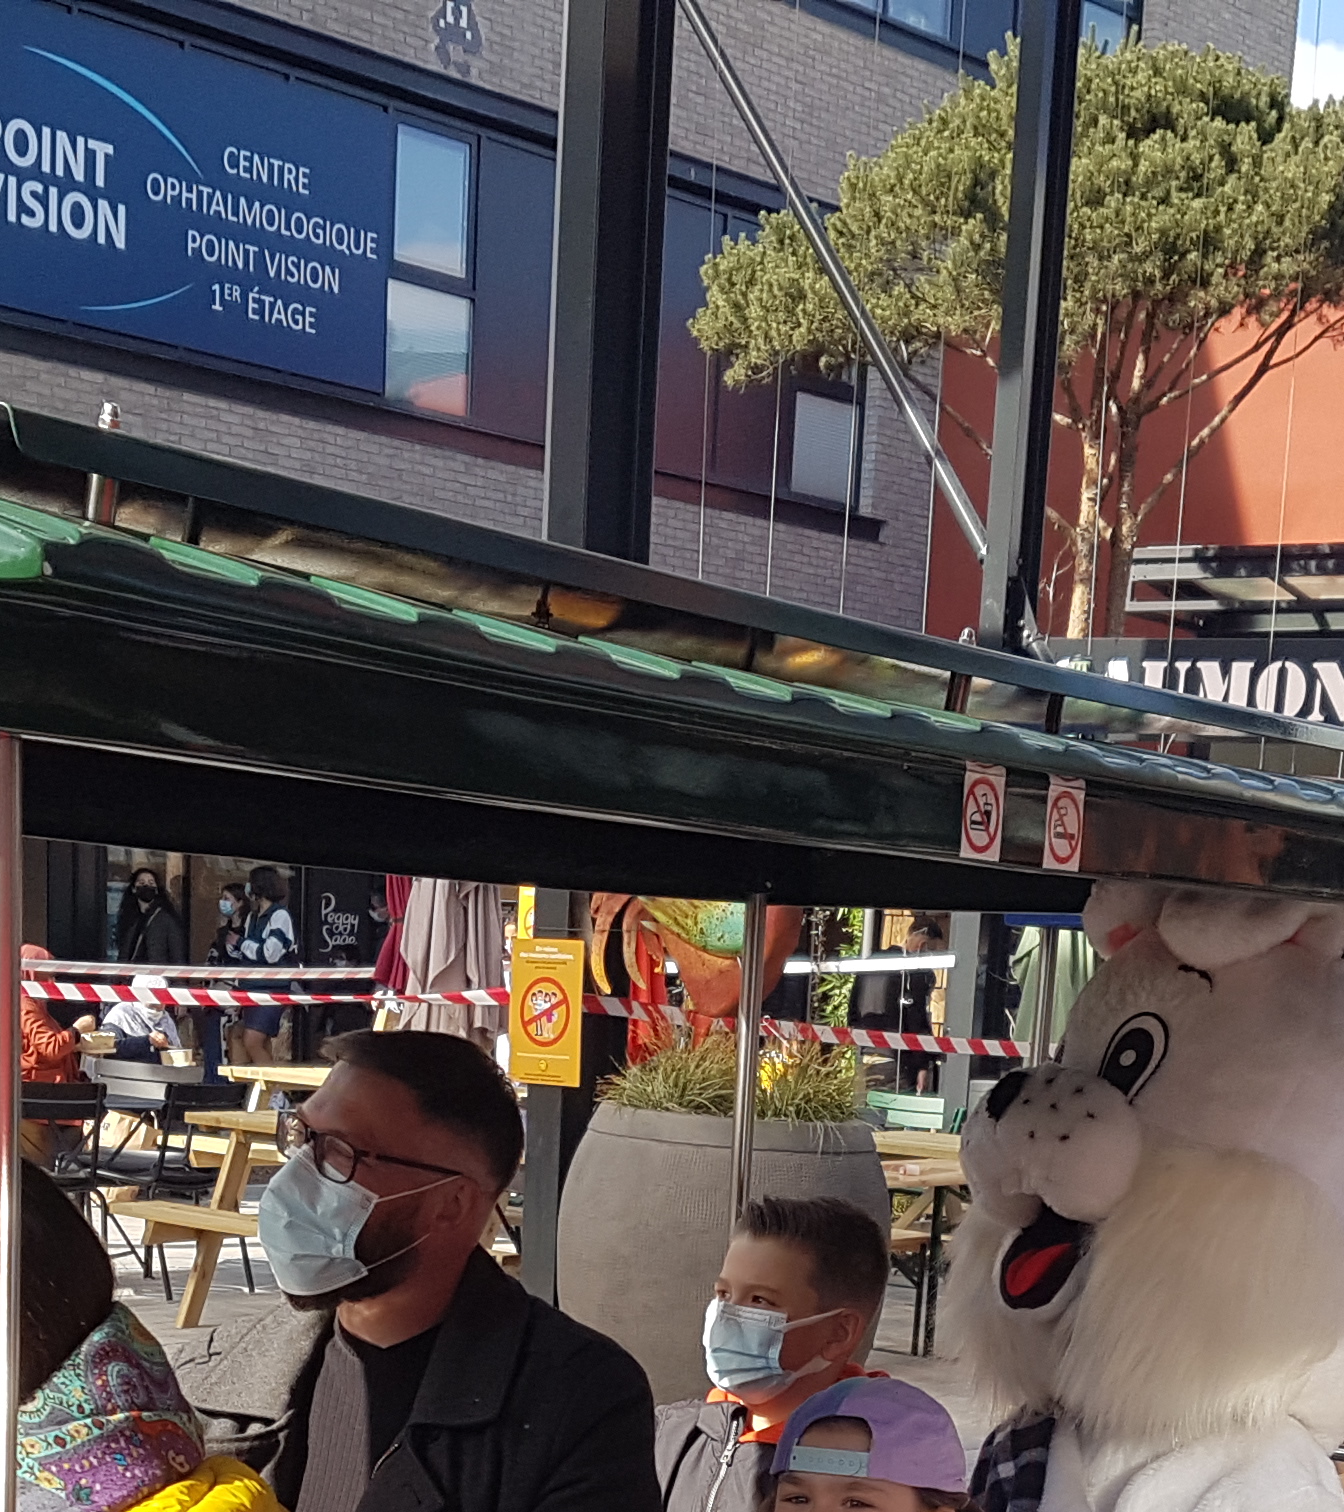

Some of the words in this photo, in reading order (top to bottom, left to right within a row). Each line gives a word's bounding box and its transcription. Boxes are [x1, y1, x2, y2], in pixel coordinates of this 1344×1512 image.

[223, 145, 311, 195] CENTRE
[146, 172, 378, 260] OPHTALMOLOGIQUE
[186, 229, 258, 272] POINT
[264, 249, 340, 294] VISION
[247, 287, 317, 334] ÉTAGE
[321, 892, 359, 935] Peggy
